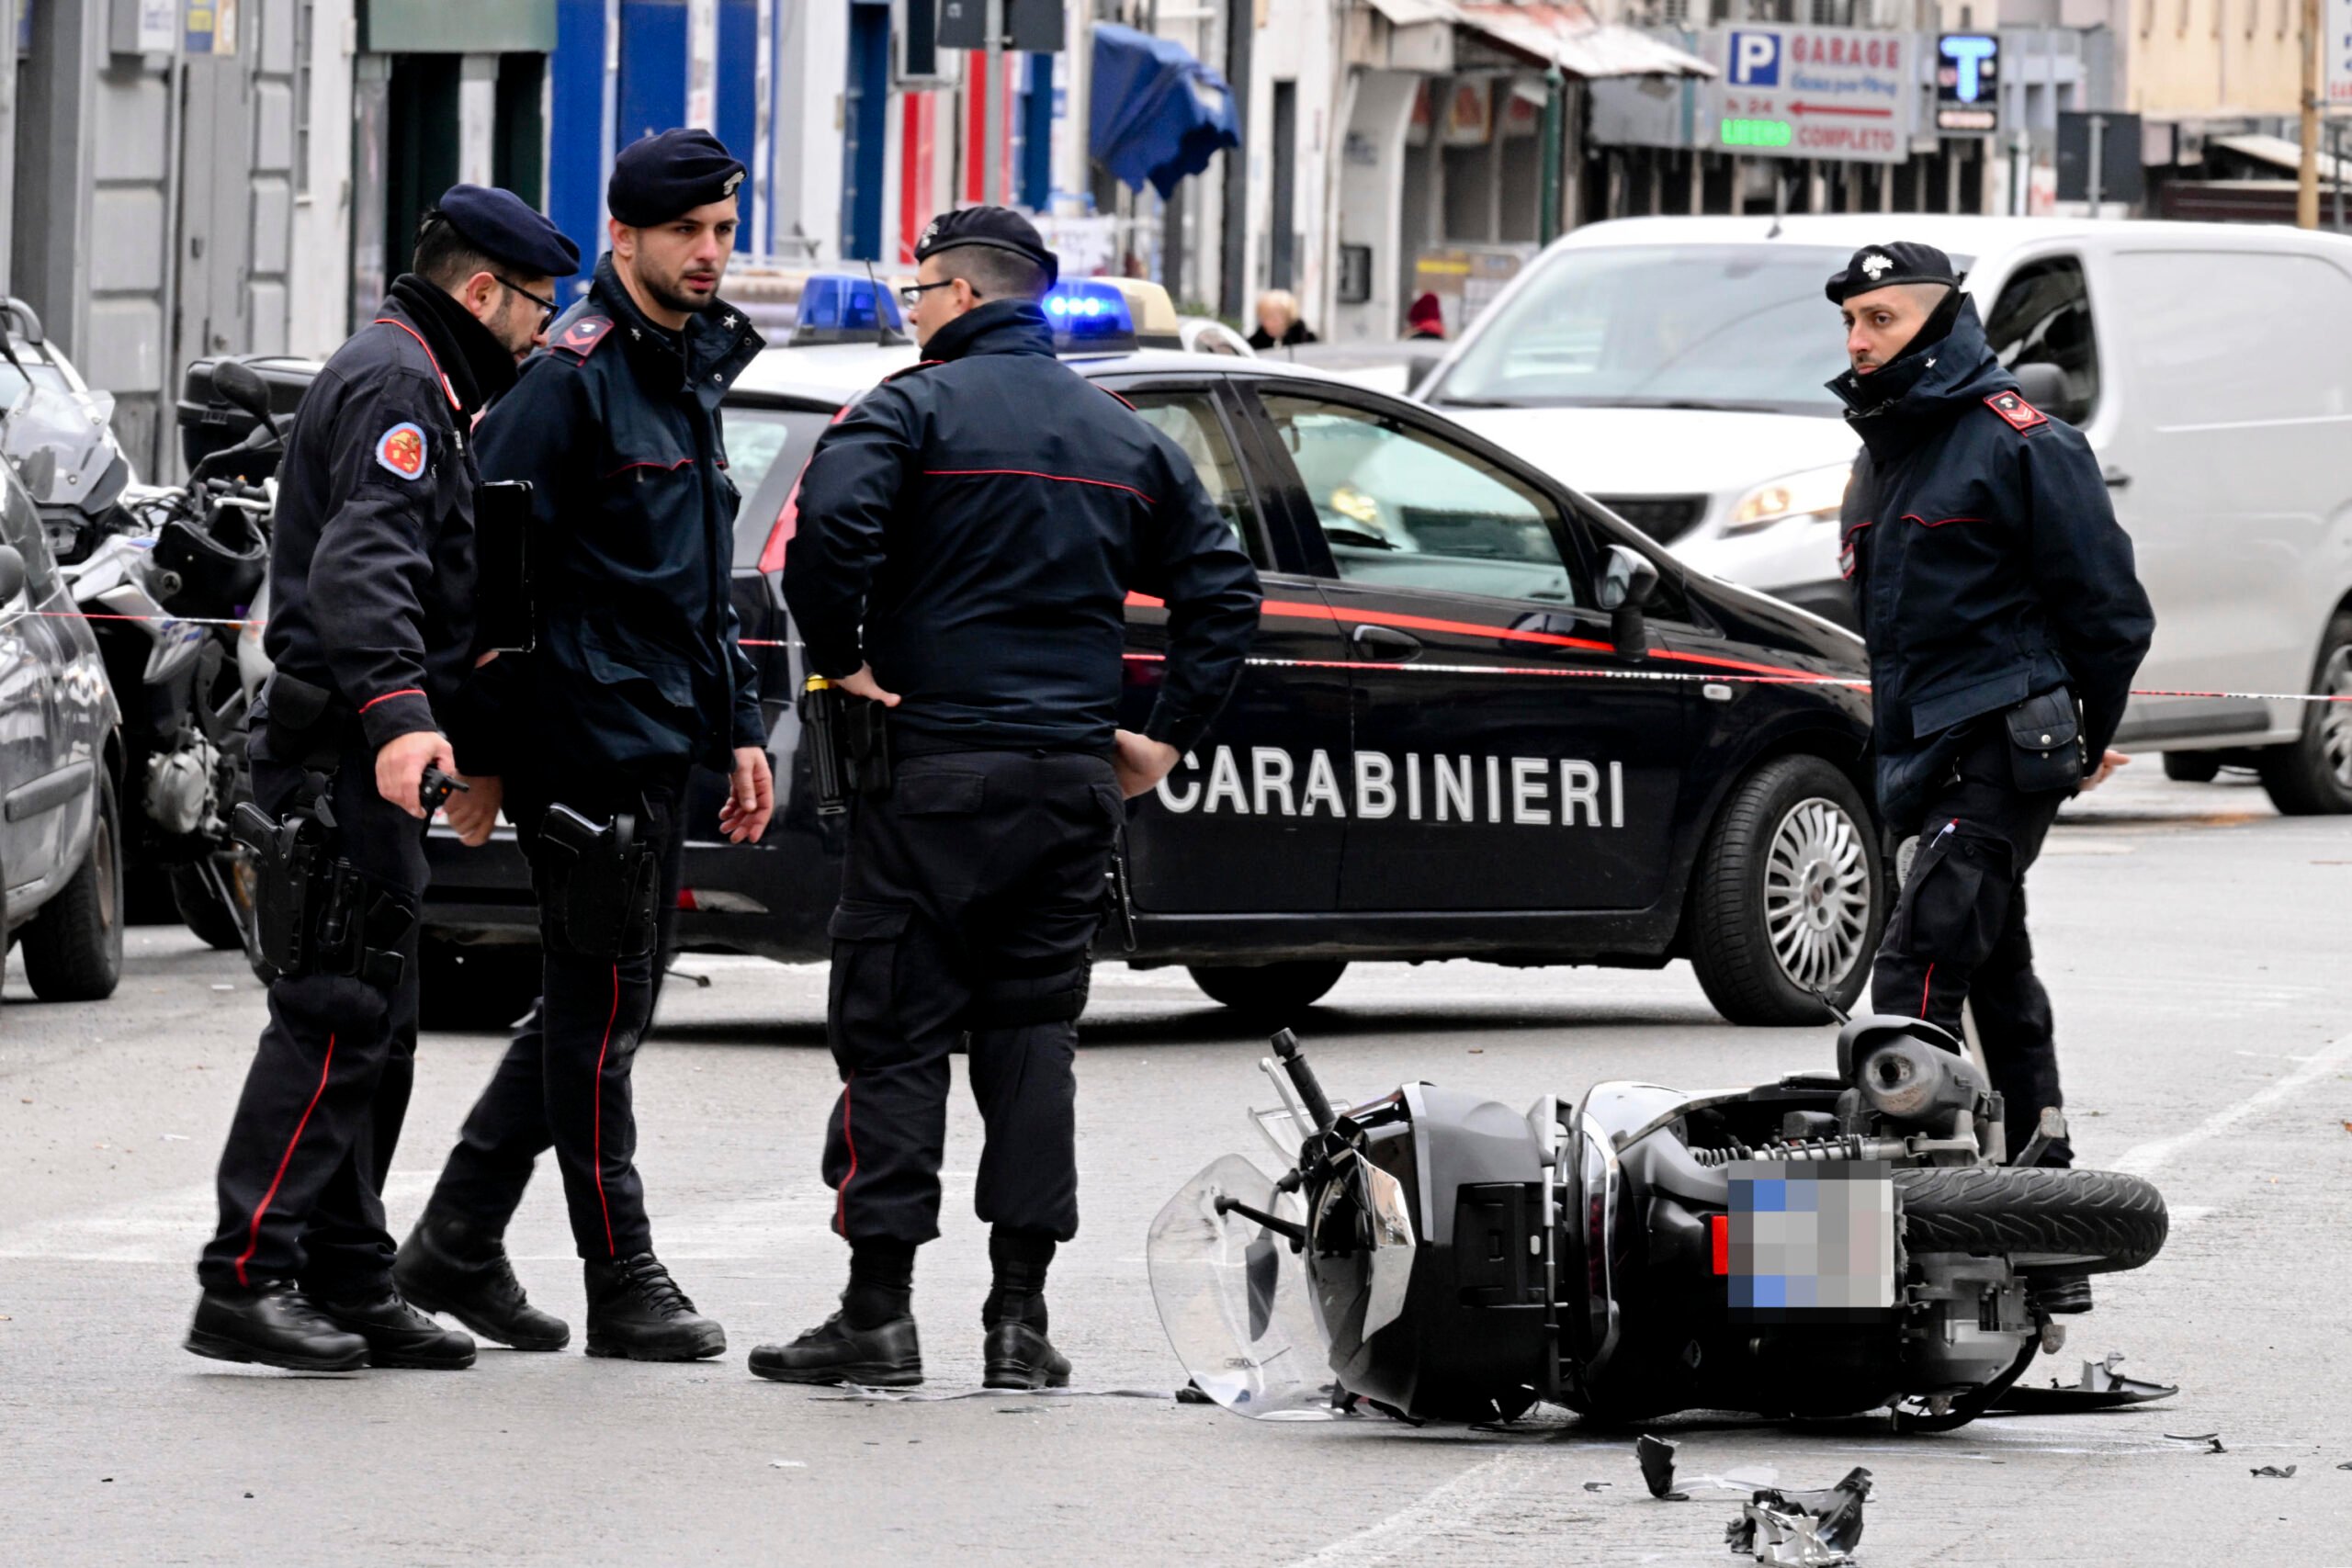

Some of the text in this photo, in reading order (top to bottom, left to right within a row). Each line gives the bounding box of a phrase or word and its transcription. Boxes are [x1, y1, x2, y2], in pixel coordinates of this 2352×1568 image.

[1737, 35, 1775, 84] P
[1792, 35, 1899, 69] GARAGE
[1940, 36, 1996, 103] T
[1722, 118, 1792, 147] LIBERO
[1797, 126, 1895, 152] COMPLETO
[1157, 745, 1624, 828] CARABINIERI
